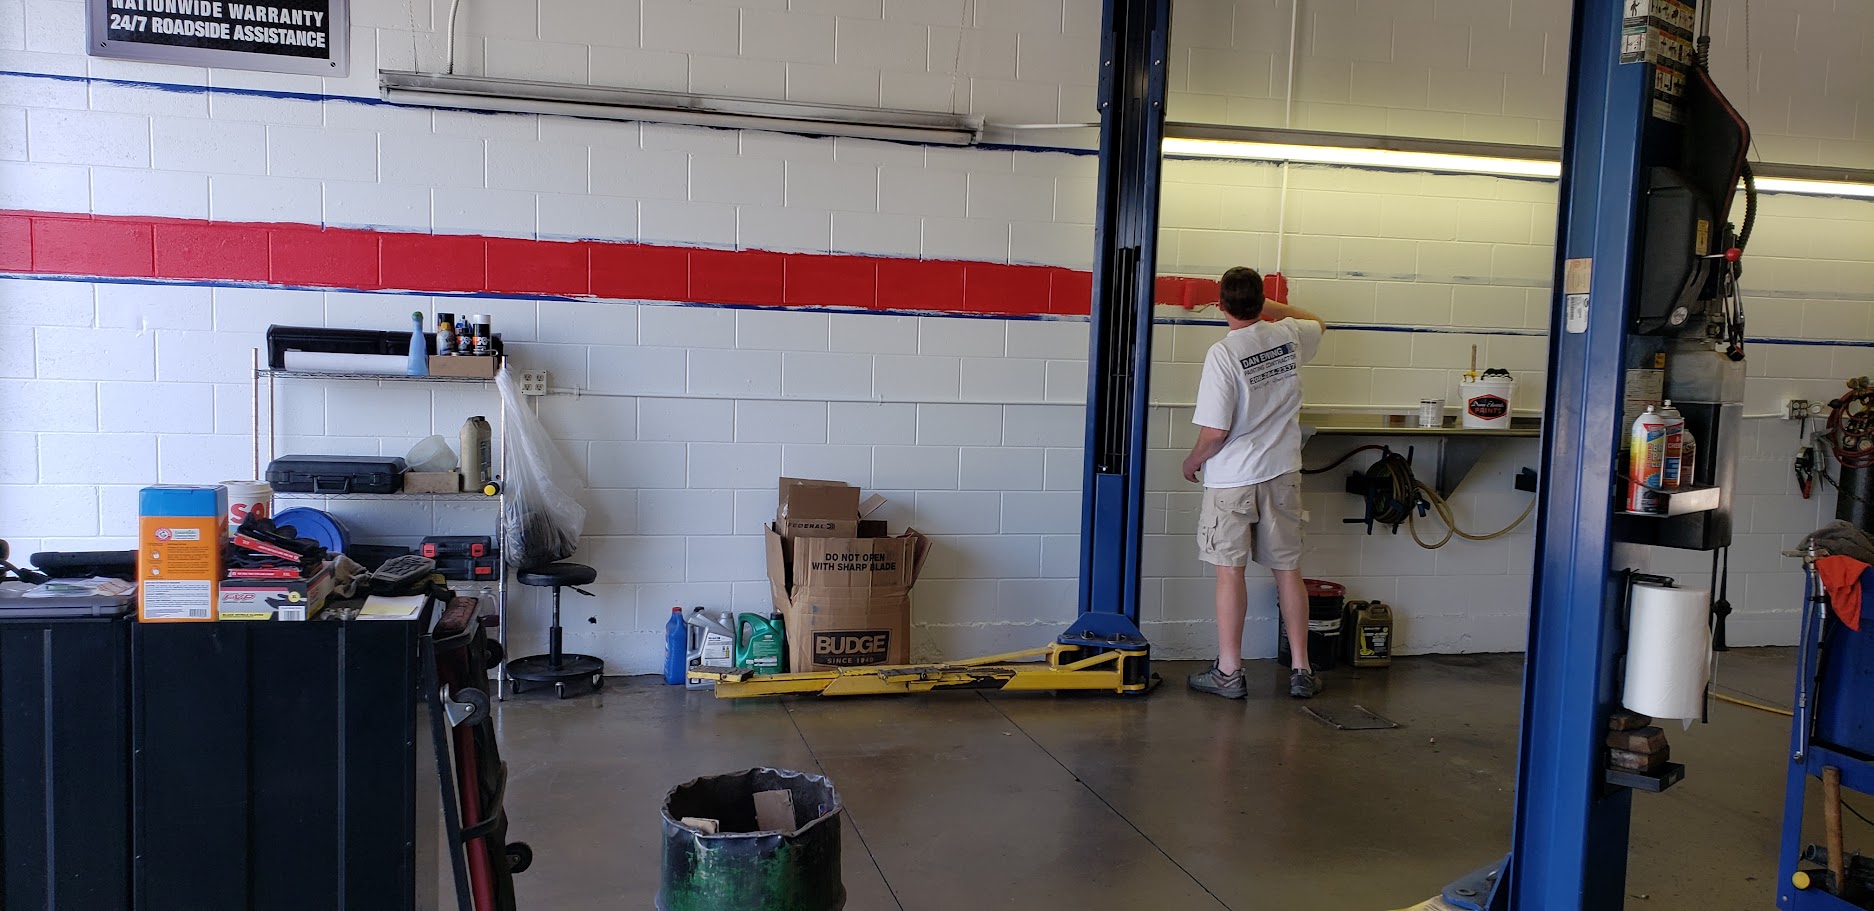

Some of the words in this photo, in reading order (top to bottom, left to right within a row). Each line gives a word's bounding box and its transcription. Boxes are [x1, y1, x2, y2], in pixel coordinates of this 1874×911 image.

[229, 3, 324, 27] WARRANTY
[110, 14, 147, 32] 24/7
[152, 17, 230, 39] ROADSIDE
[233, 25, 326, 48] ASSISTANCE
[1242, 356, 1260, 368] DAN
[1260, 347, 1284, 362] EWING
[812, 562, 835, 571] WITH
[837, 562, 867, 571] SHARP
[870, 562, 896, 571] BLADE
[825, 553, 838, 561] DO
[841, 553, 860, 561] NOT
[862, 553, 885, 561] OPEN
[816, 635, 886, 654] BUDGE
